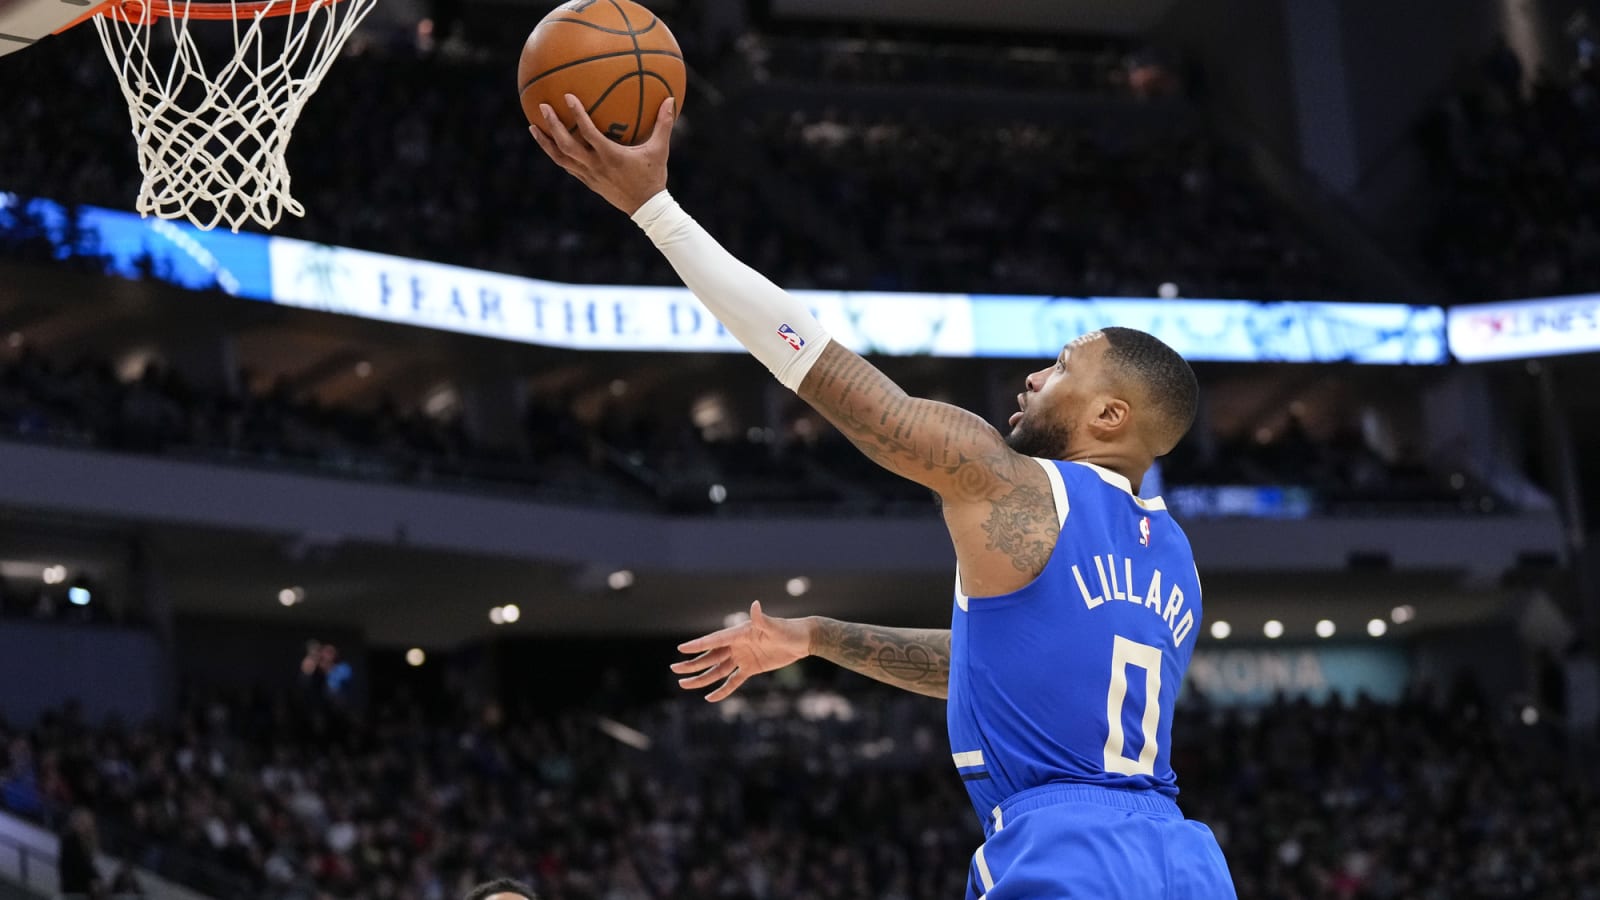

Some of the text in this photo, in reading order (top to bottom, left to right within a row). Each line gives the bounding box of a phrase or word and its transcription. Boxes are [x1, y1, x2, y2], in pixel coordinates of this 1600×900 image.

[378, 270, 504, 323] FEAR
[530, 295, 640, 336] THE
[1071, 554, 1194, 648] LILLARD
[1103, 634, 1162, 777] 0
